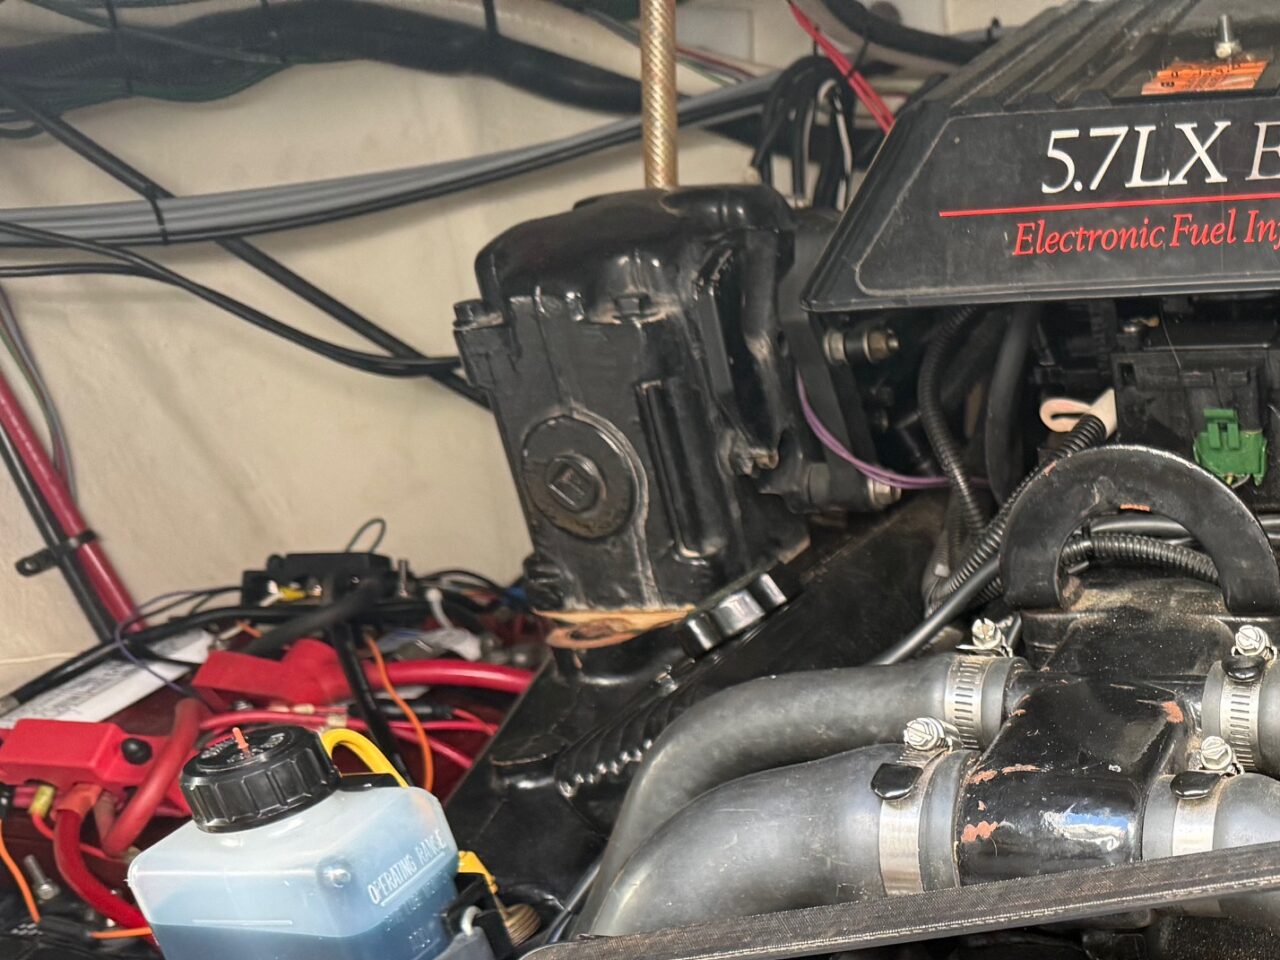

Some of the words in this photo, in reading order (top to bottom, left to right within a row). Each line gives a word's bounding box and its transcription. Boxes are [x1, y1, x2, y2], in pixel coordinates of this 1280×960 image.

[1041, 121, 1231, 194] 5.7LX
[1012, 217, 1166, 256] Electronic
[1169, 208, 1237, 248] Fuel
[367, 853, 417, 905] OPERATING
